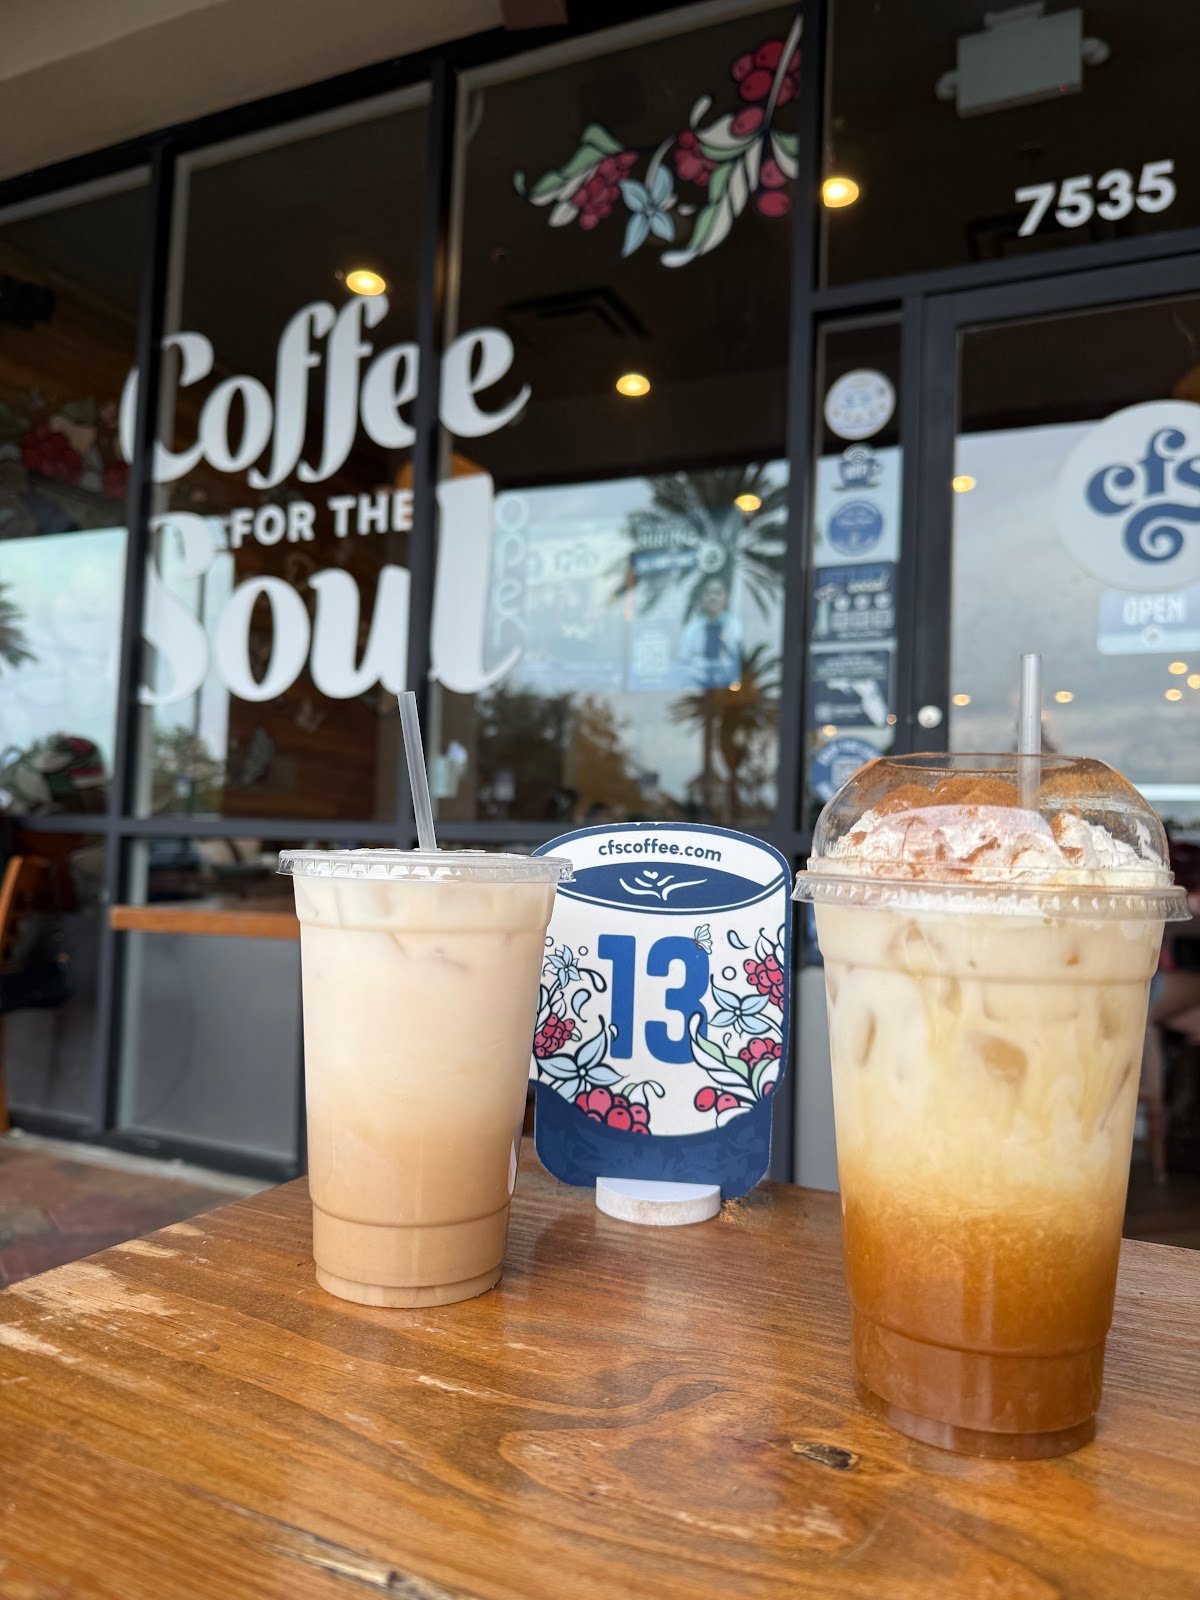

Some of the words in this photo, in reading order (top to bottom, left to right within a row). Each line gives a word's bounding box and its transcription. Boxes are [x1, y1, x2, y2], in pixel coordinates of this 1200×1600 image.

[1014, 159, 1177, 237] 7535
[119, 294, 532, 490] Coffee
[229, 500, 316, 549] FOR
[327, 489, 414, 539] THE
[138, 471, 522, 706] Soul
[1122, 593, 1187, 626] OPEN
[598, 838, 722, 862] cfscoffee.com
[597, 934, 710, 1065] 13
